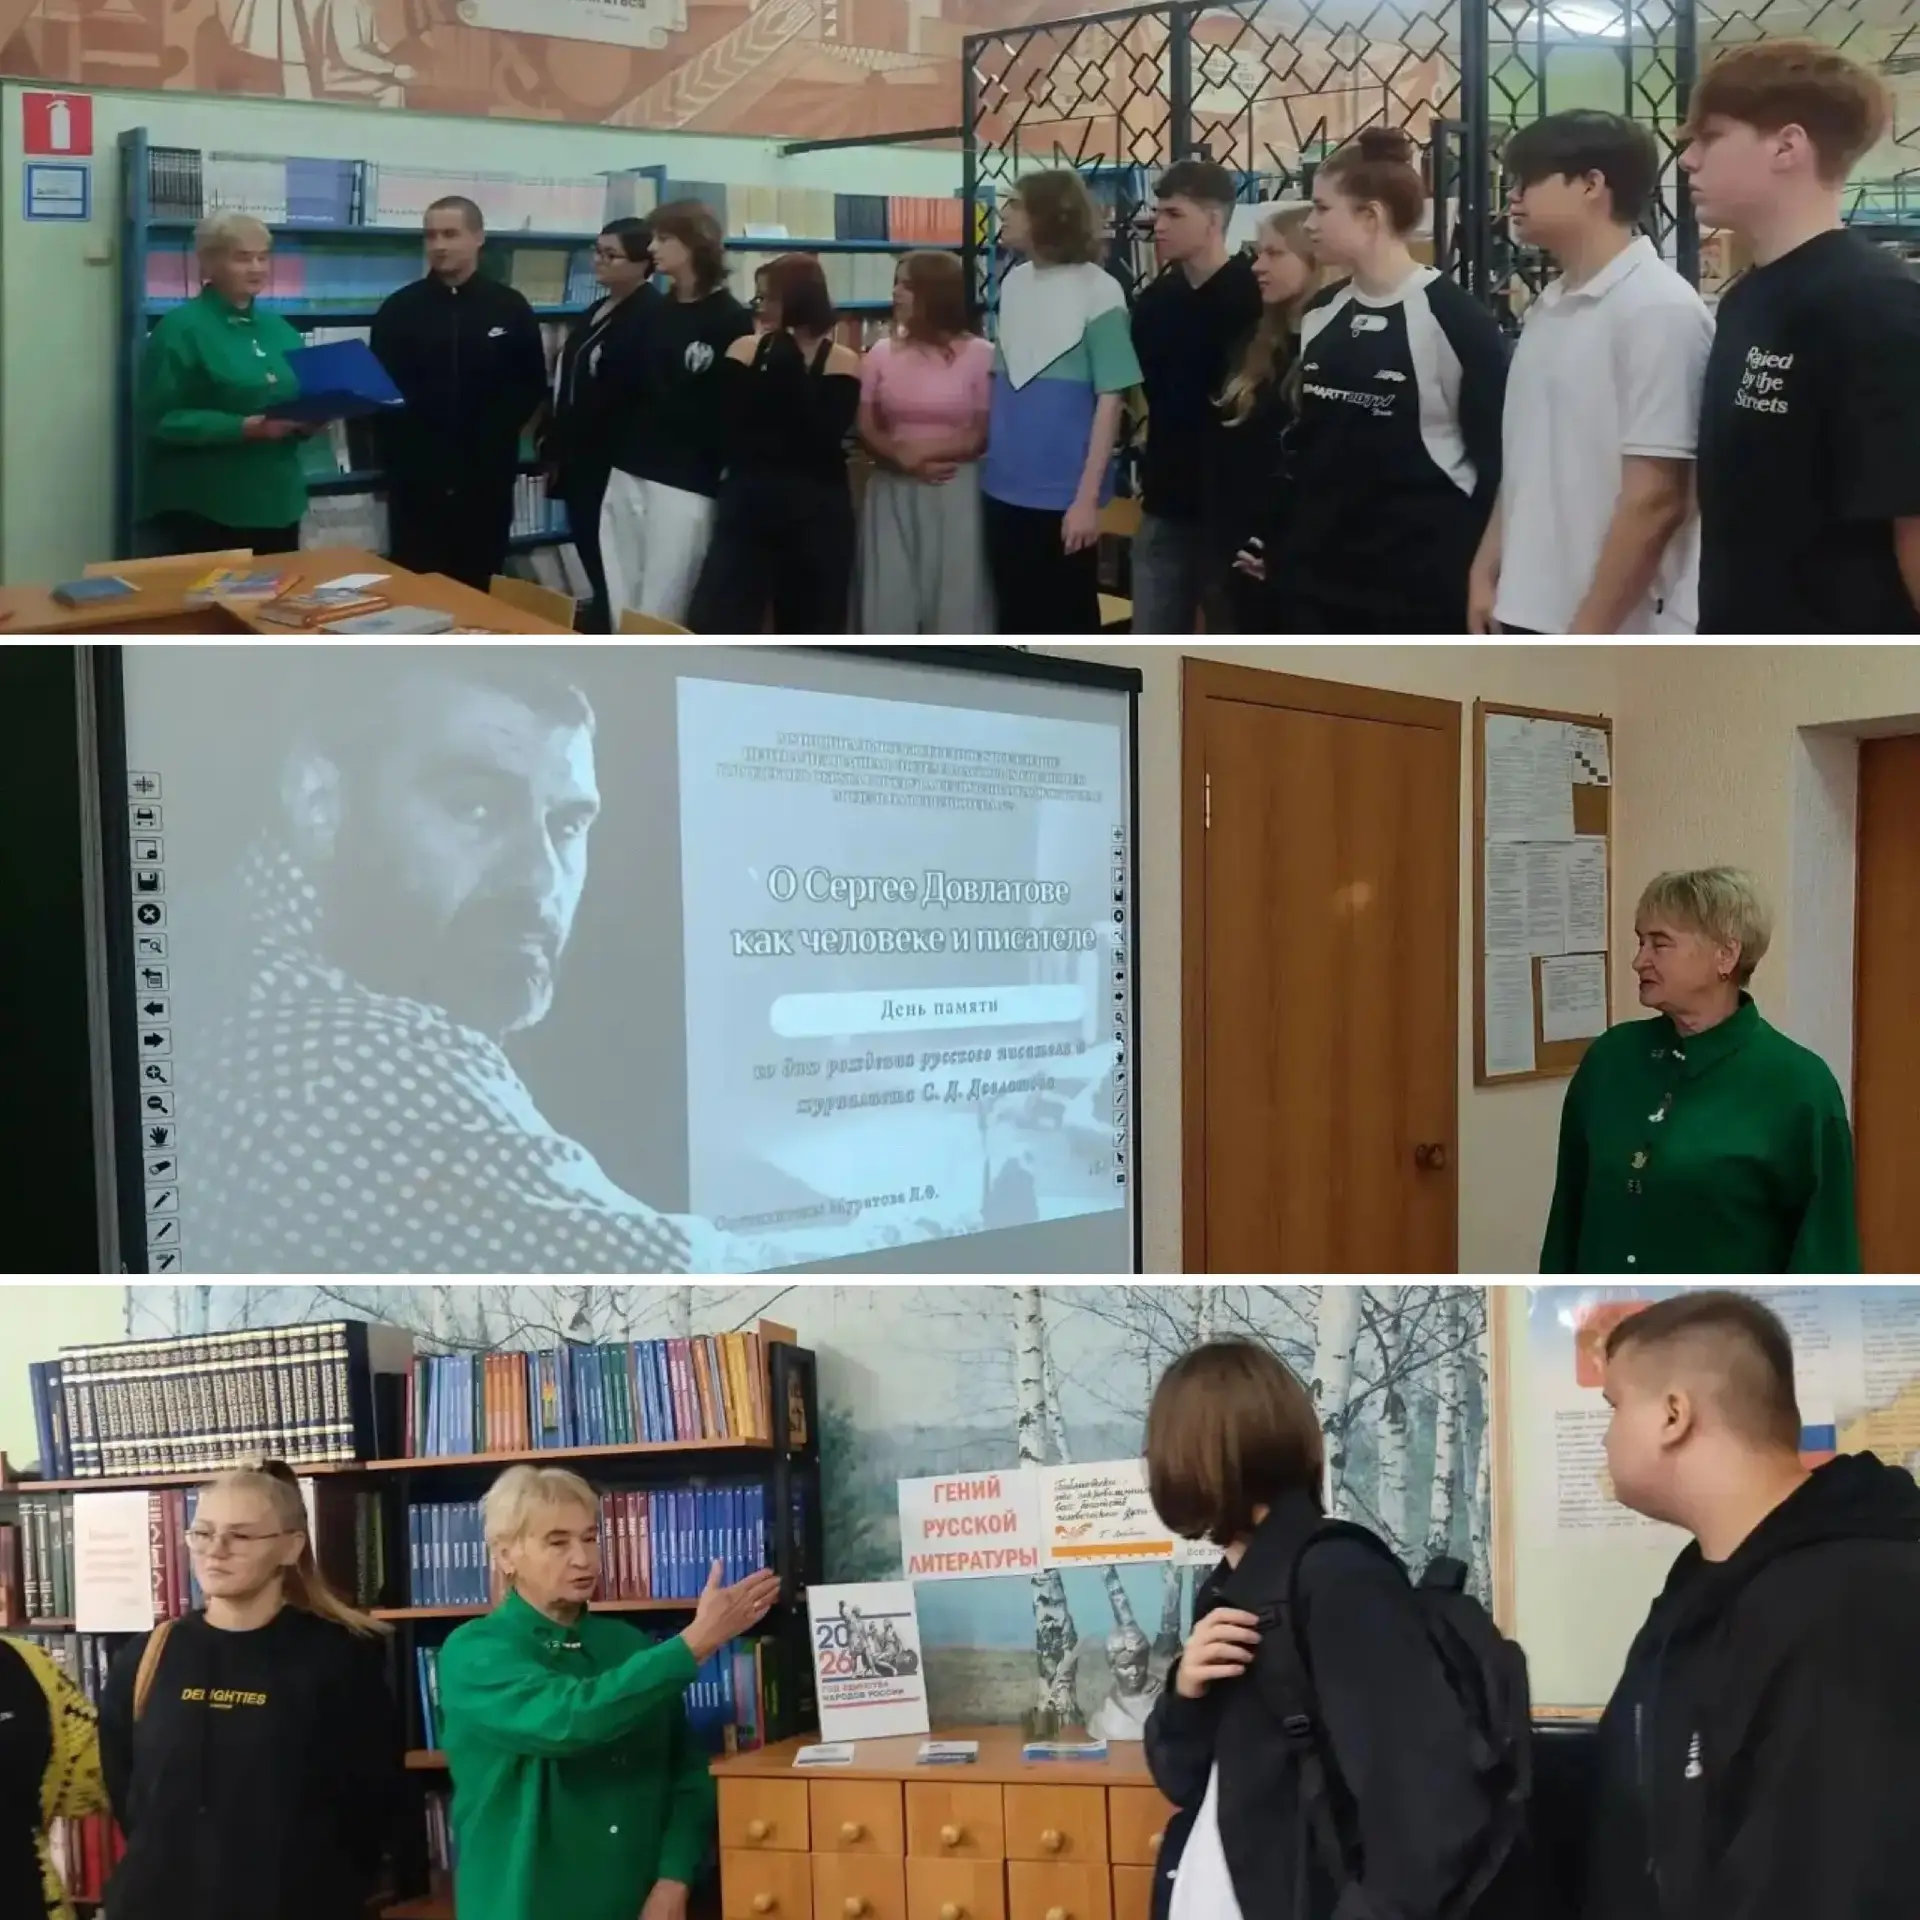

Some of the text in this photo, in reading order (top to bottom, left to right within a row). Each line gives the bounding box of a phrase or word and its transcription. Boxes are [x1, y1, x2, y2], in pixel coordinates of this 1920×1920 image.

[767, 865, 1070, 908] О Сергее Довлатове
[732, 926, 1097, 957] как человеке и писателе
[881, 999, 999, 1021] День памяти
[933, 1474, 1002, 1504] ГЕНИЙ
[923, 1508, 1018, 1539] РУССКОЙ
[909, 1547, 1039, 1574] ЛИТЕРАТУРЫ
[816, 1623, 850, 1649] 20
[819, 1650, 856, 1675] 26
